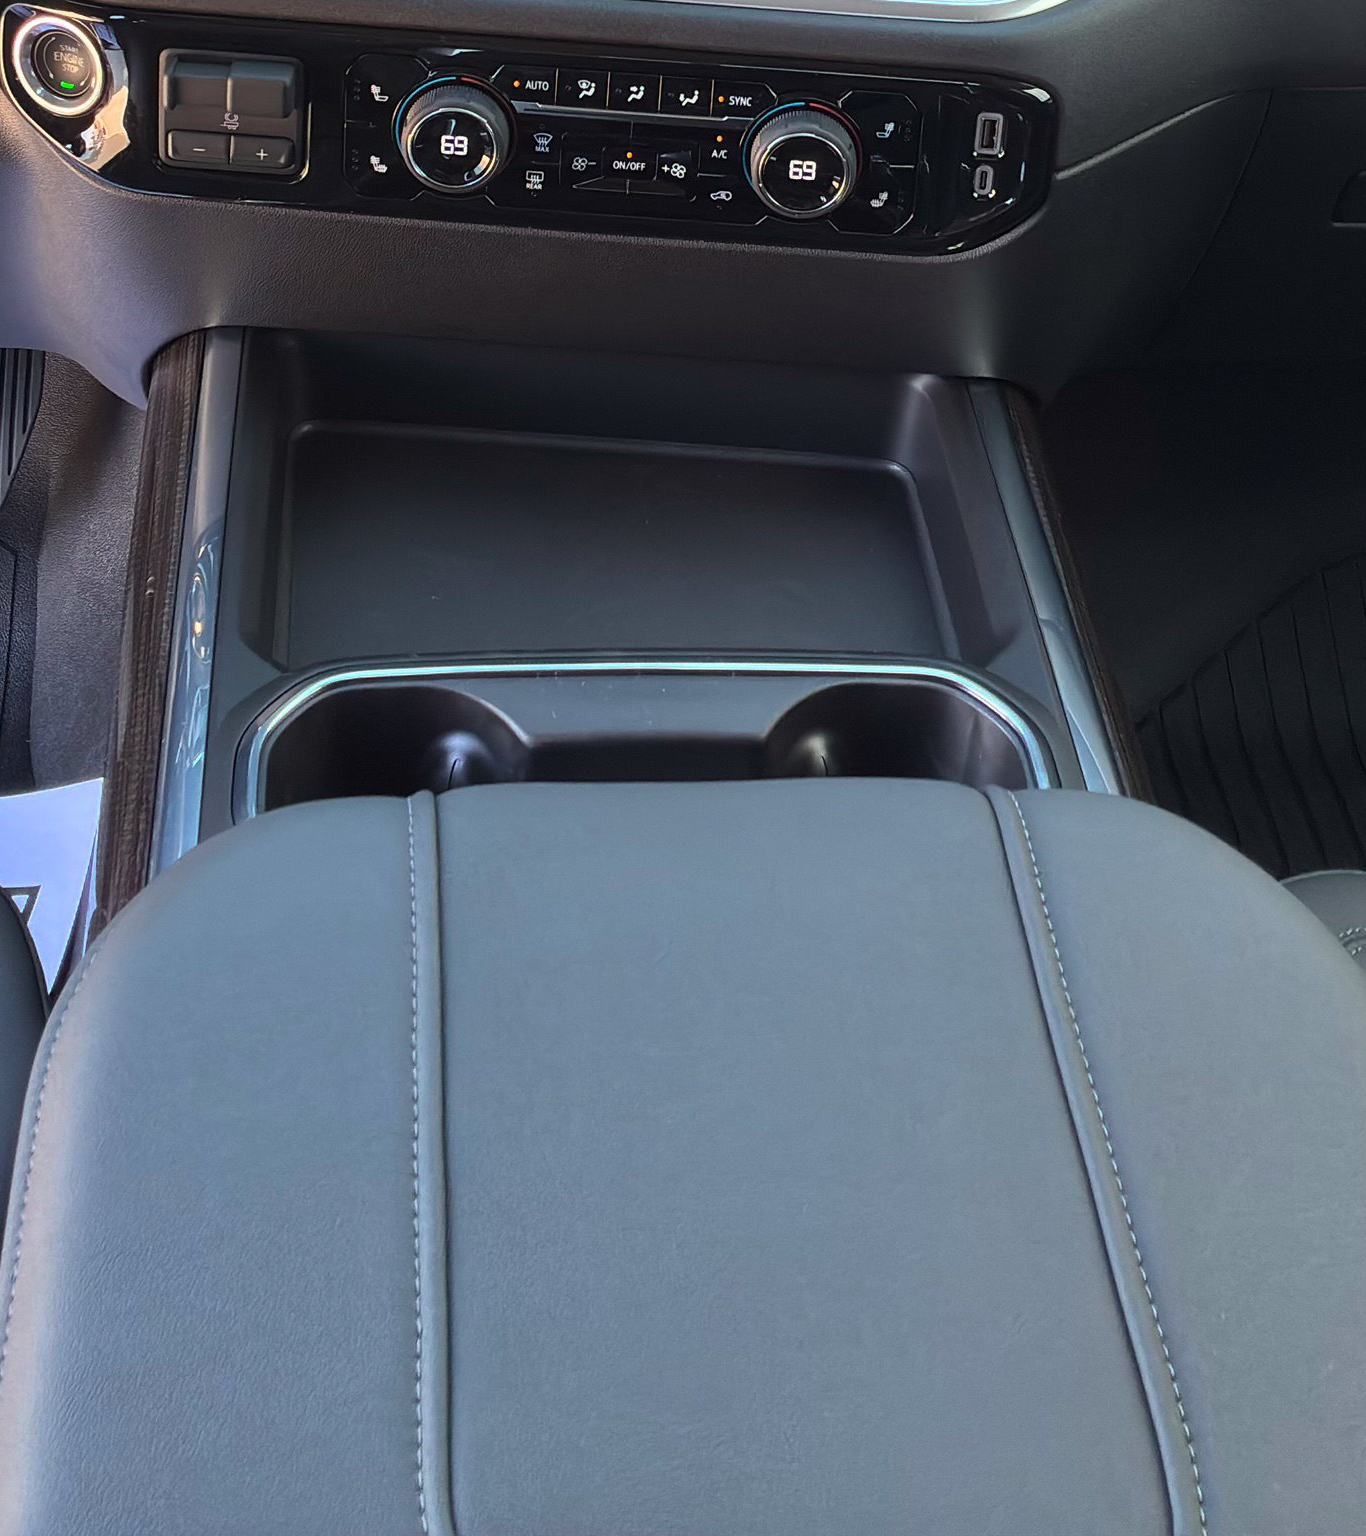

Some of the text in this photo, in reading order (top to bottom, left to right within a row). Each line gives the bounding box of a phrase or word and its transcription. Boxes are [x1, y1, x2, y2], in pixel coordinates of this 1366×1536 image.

[59, 44, 79, 54] START
[53, 51, 84, 68] ENGINE
[62, 63, 80, 74] STOP
[525, 80, 550, 92] AUTO
[728, 95, 753, 107] SYNC
[440, 135, 468, 156] 69
[710, 149, 728, 160] A/C
[612, 160, 646, 172] ON/OFF
[788, 159, 817, 181] 69
[525, 181, 543, 191] REAR
